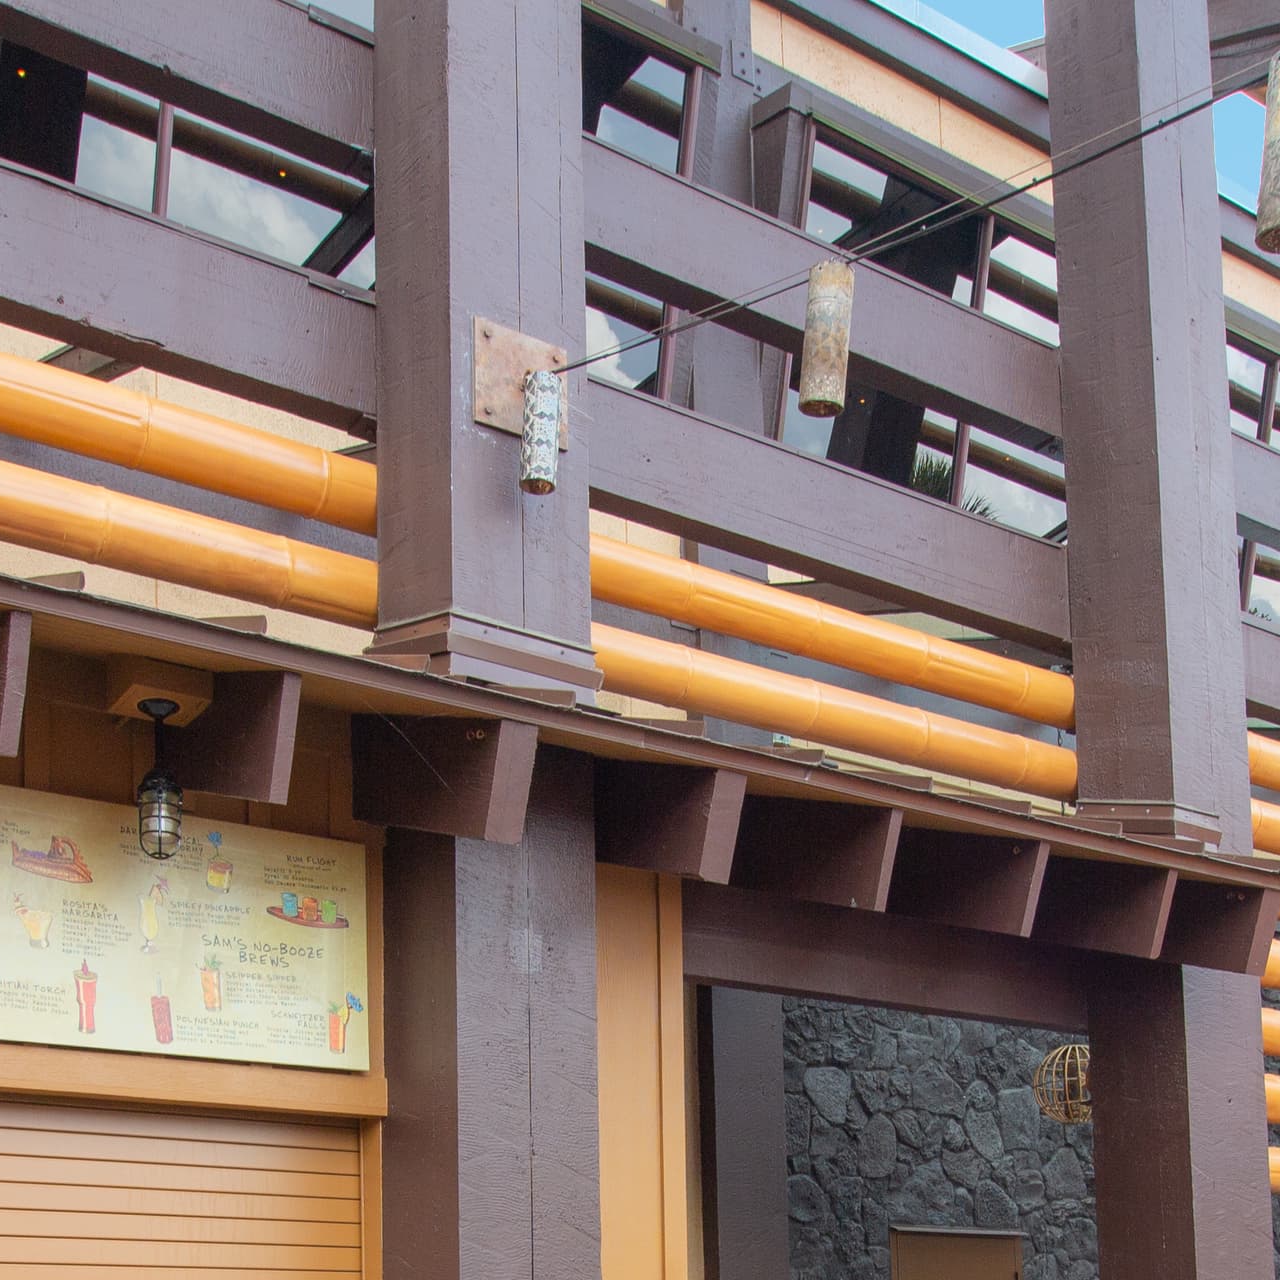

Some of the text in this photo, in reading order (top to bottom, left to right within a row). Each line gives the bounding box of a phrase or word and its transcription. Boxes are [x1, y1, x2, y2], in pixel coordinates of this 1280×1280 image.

[306, 856, 336, 867] FLIGHT
[62, 898, 108, 912] ROSITA'S
[62, 908, 119, 923] MARGARITA
[201, 934, 325, 959] SAM'S NO-BOOZE
[239, 951, 290, 968] BREWS
[33, 984, 66, 996] TORCH
[176, 1015, 229, 1027] POLYNESIAN
